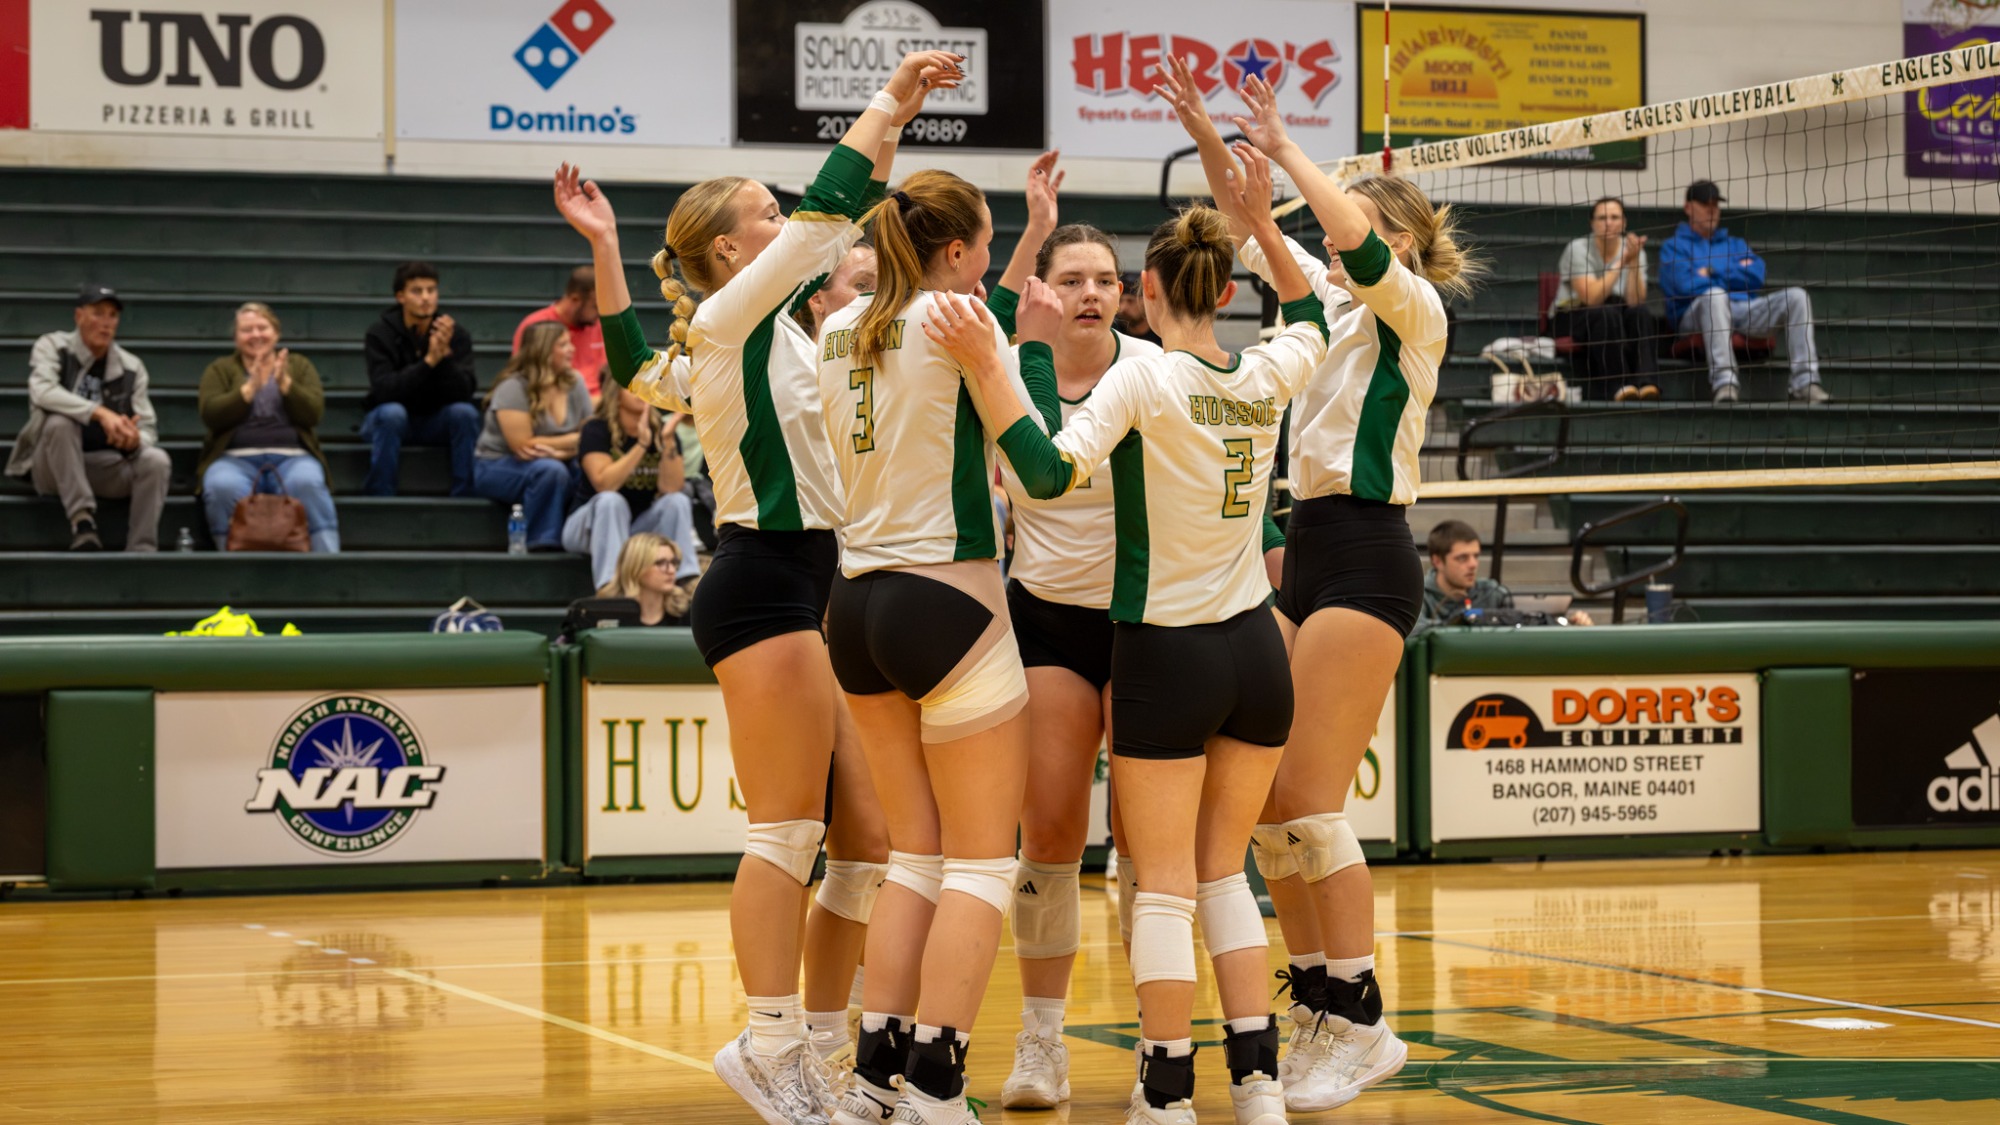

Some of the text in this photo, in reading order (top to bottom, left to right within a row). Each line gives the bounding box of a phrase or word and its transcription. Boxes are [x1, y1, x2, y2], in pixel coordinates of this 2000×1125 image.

[1533, 43, 1607, 54] SANDWICHES
[1549, 30, 1588, 40] PANINI
[90, 9, 325, 91] UNO
[804, 35, 890, 71] SCHOOL
[1392, 28, 1507, 73] HARVEST
[1529, 58, 1611, 71] FRESH SALADS
[1070, 31, 1339, 105] HERO'S
[1424, 60, 1474, 74] MOON
[1528, 74, 1613, 87] HANDCRAFTED
[1882, 52, 1953, 86] EAGLES
[805, 76, 872, 99] PICTURE
[1430, 79, 1468, 94] DELI
[1552, 88, 1589, 99] SOUPS
[103, 104, 314, 129] PIZZERIA & GRILL
[490, 104, 636, 133] Domino's
[1625, 82, 1796, 131] EAGLES VOLLEYBALL
[1411, 142, 1460, 167] EAGLES
[1466, 126, 1552, 157] VOLLEYBALL
[849, 366, 875, 454] 3
[1222, 438, 1255, 519] 2
[1552, 686, 1741, 726] DORR'S
[276, 698, 420, 761] NORTH ATLANTIC
[1562, 728, 1734, 746] EQUIPMENT
[1485, 755, 1705, 775] 1468 HAMMOND STREET
[244, 765, 445, 813] NAC
[1493, 780, 1695, 800] BANGOR, MAINE 04401
[290, 811, 408, 850] CONFERENCE
[1533, 805, 1657, 827] (207) 945-5965
